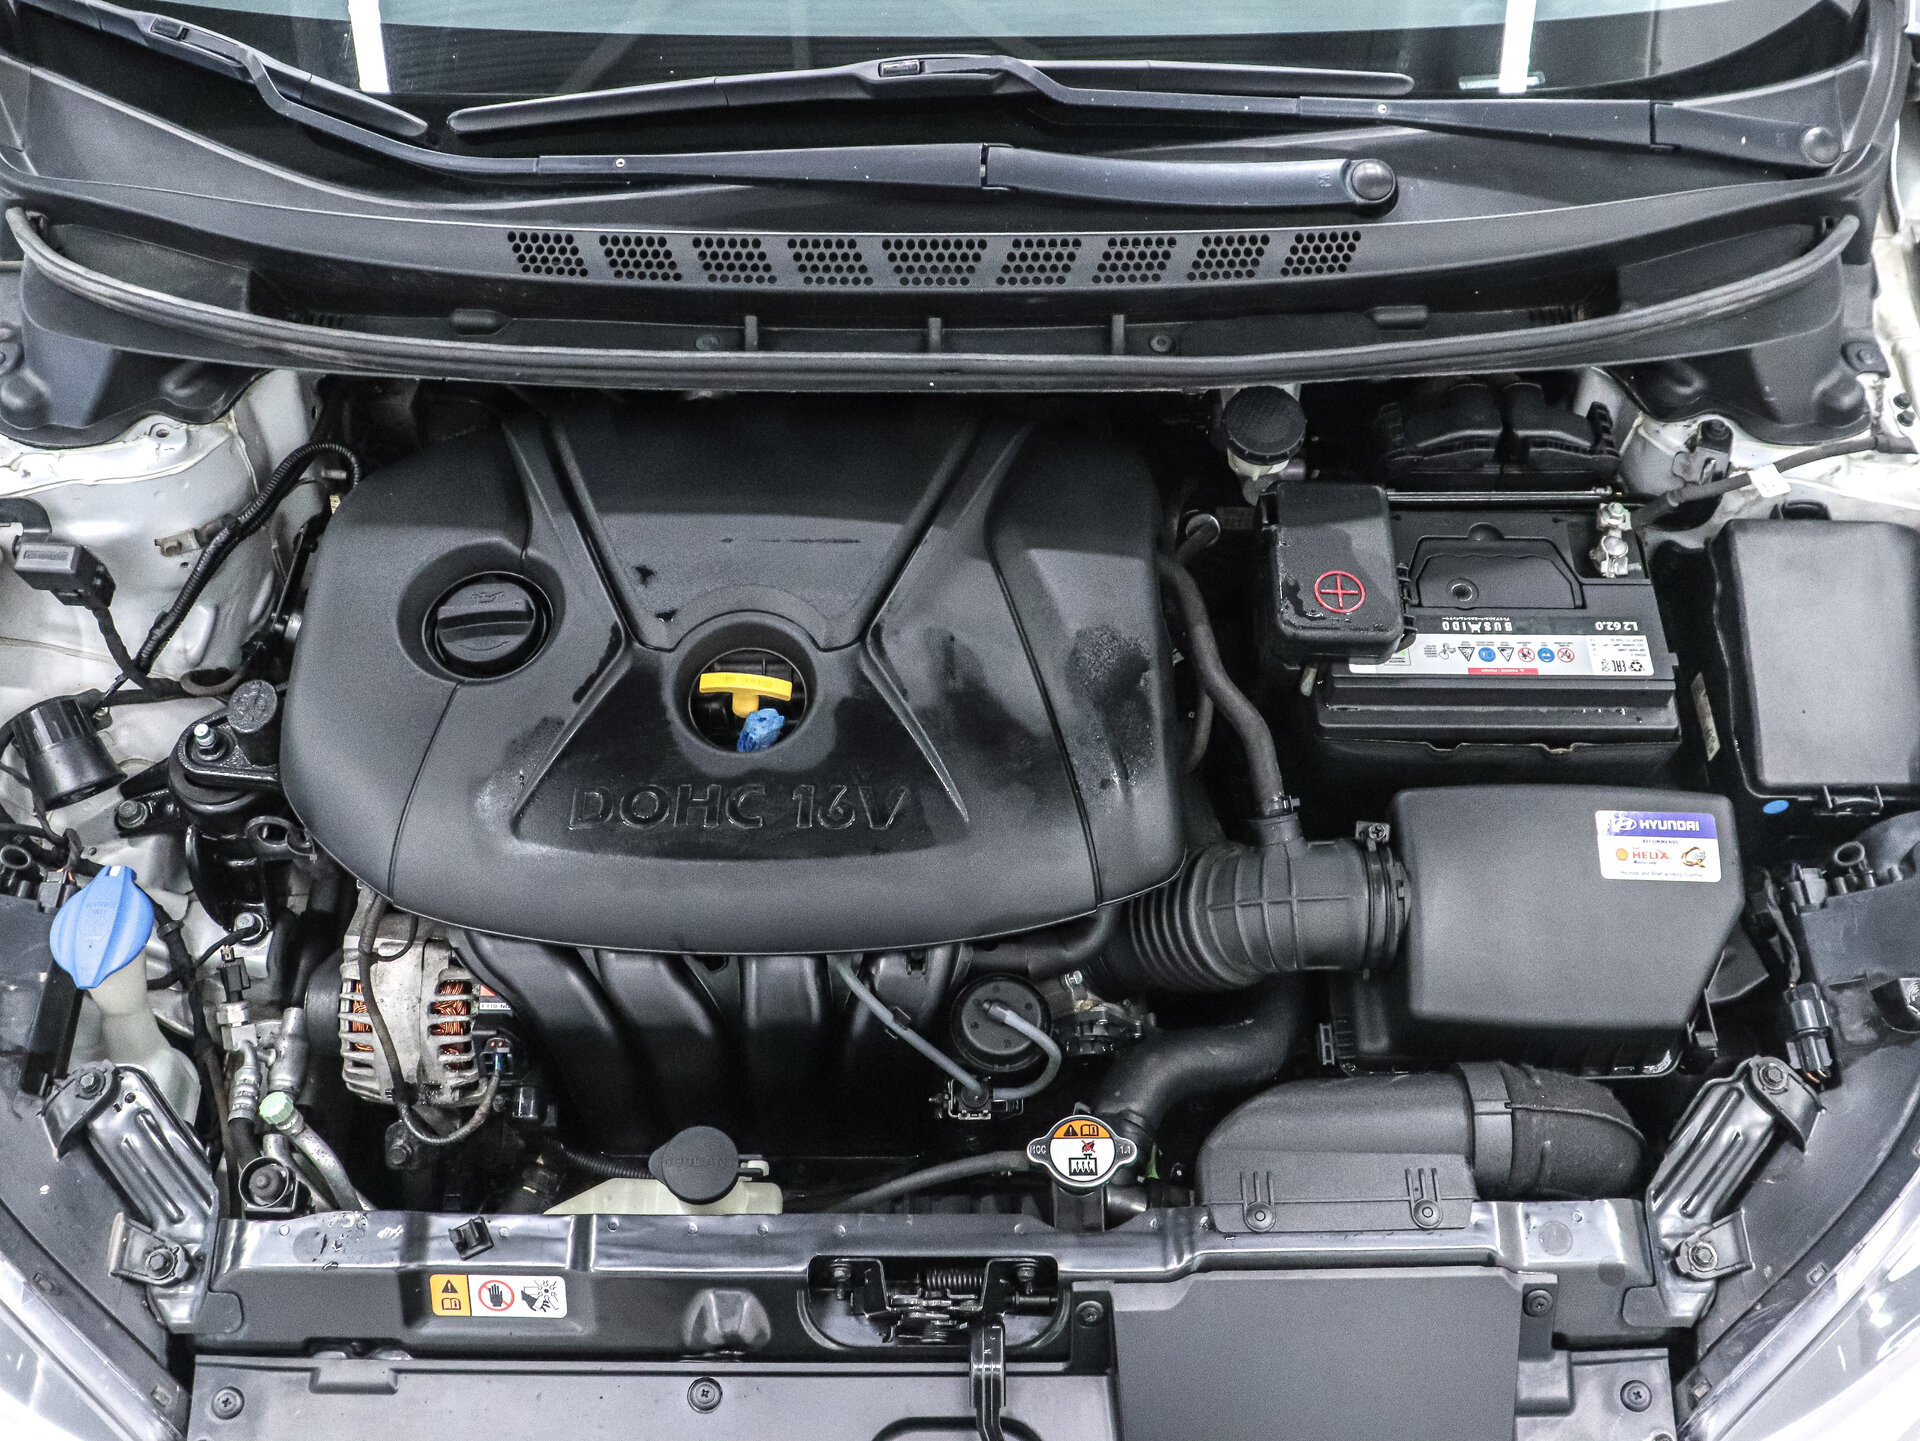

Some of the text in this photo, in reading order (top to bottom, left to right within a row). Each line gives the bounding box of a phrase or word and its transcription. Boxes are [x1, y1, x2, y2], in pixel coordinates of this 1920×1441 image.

[1595, 621, 1639, 632] L2 62.0
[568, 783, 911, 831] DOHC 16V
[1639, 819, 1700, 831] HYUNDAI
[1632, 849, 1670, 860] HELIX
